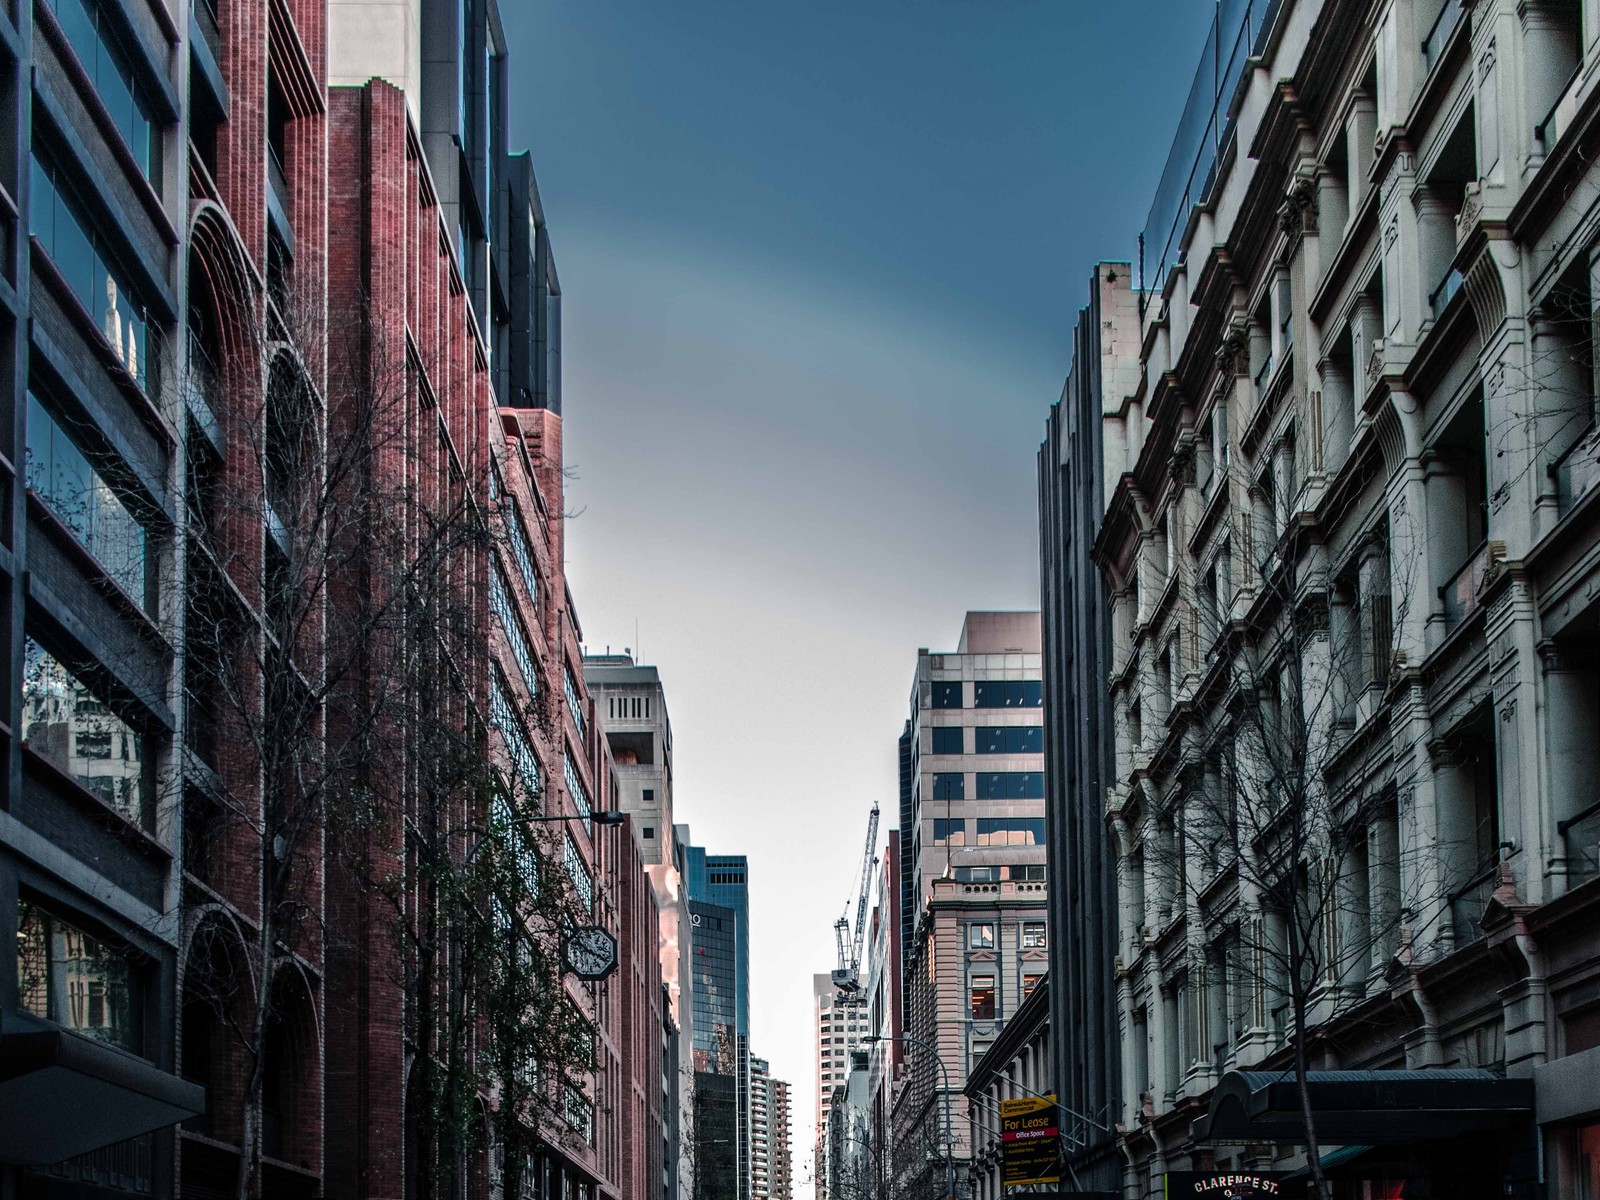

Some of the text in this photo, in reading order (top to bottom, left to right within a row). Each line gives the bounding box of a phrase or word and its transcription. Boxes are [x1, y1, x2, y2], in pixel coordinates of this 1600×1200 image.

[1005, 1117, 1049, 1130] For Lease
[1015, 1130, 1045, 1139] Office Space
[1194, 1175, 1279, 1195] CLARENCE ST.
